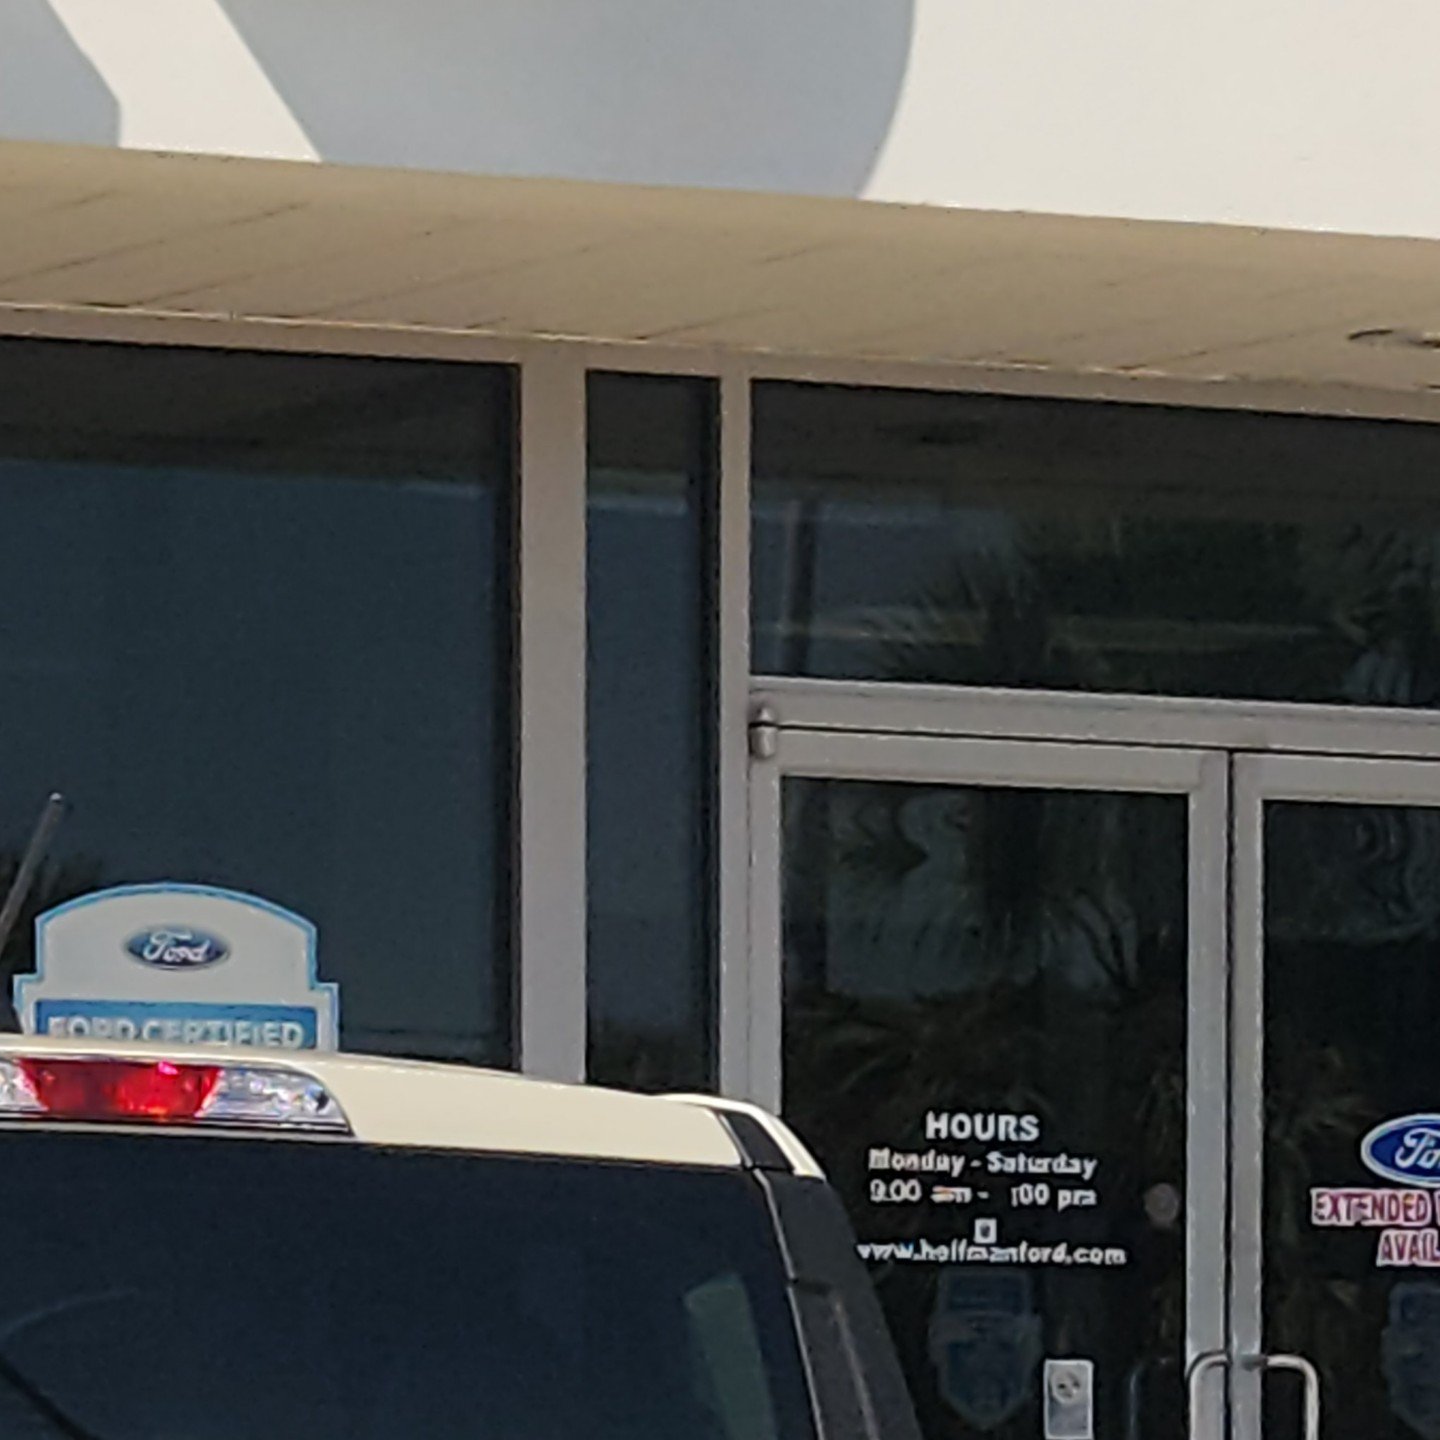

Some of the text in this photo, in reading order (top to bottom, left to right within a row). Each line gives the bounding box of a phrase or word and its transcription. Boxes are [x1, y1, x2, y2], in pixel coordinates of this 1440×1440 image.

[142, 930, 210, 962] Ford
[925, 1111, 1040, 1142] HOURS
[868, 1147, 965, 1178] Monday
[986, 1151, 1098, 1181] Saturday
[1313, 1190, 1430, 1224] EXTENDED
